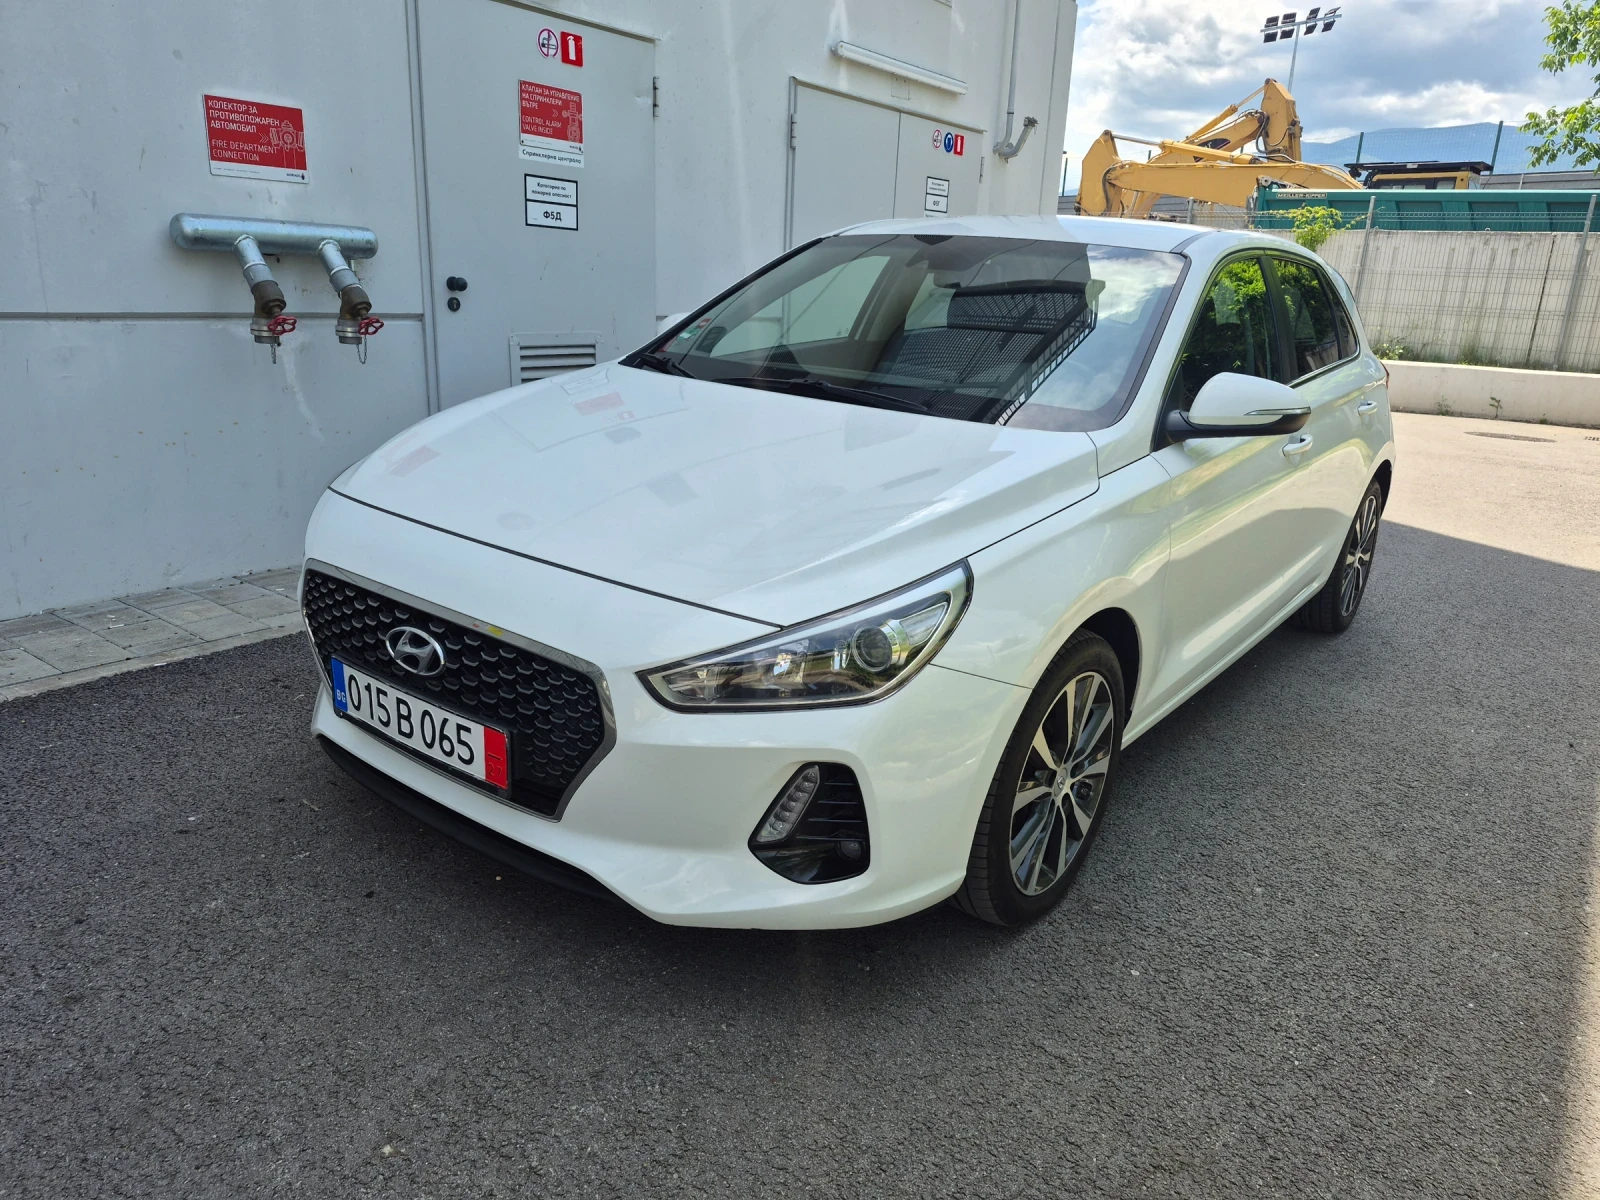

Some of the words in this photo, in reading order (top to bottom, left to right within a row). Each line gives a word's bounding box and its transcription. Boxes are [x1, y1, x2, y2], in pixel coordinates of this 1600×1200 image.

[521, 92, 529, 100] НА
[208, 100, 247, 112] КОЛЕКТОР
[248, 105, 258, 114] ЗА
[209, 110, 280, 126] ПРОТИВОПОЖАРЕН
[522, 115, 545, 126] CONTROL
[546, 119, 562, 128] ALARM
[210, 120, 256, 132] АВТОМОБИЛ
[522, 124, 537, 132] VALVE
[537, 126, 553, 135] INSIDE
[212, 139, 228, 148] FIRE
[229, 142, 278, 154] DEPARTMENT
[212, 149, 259, 161] CONNECTION
[543, 210, 562, 222] Ф5Д
[336, 690, 346, 703] BG
